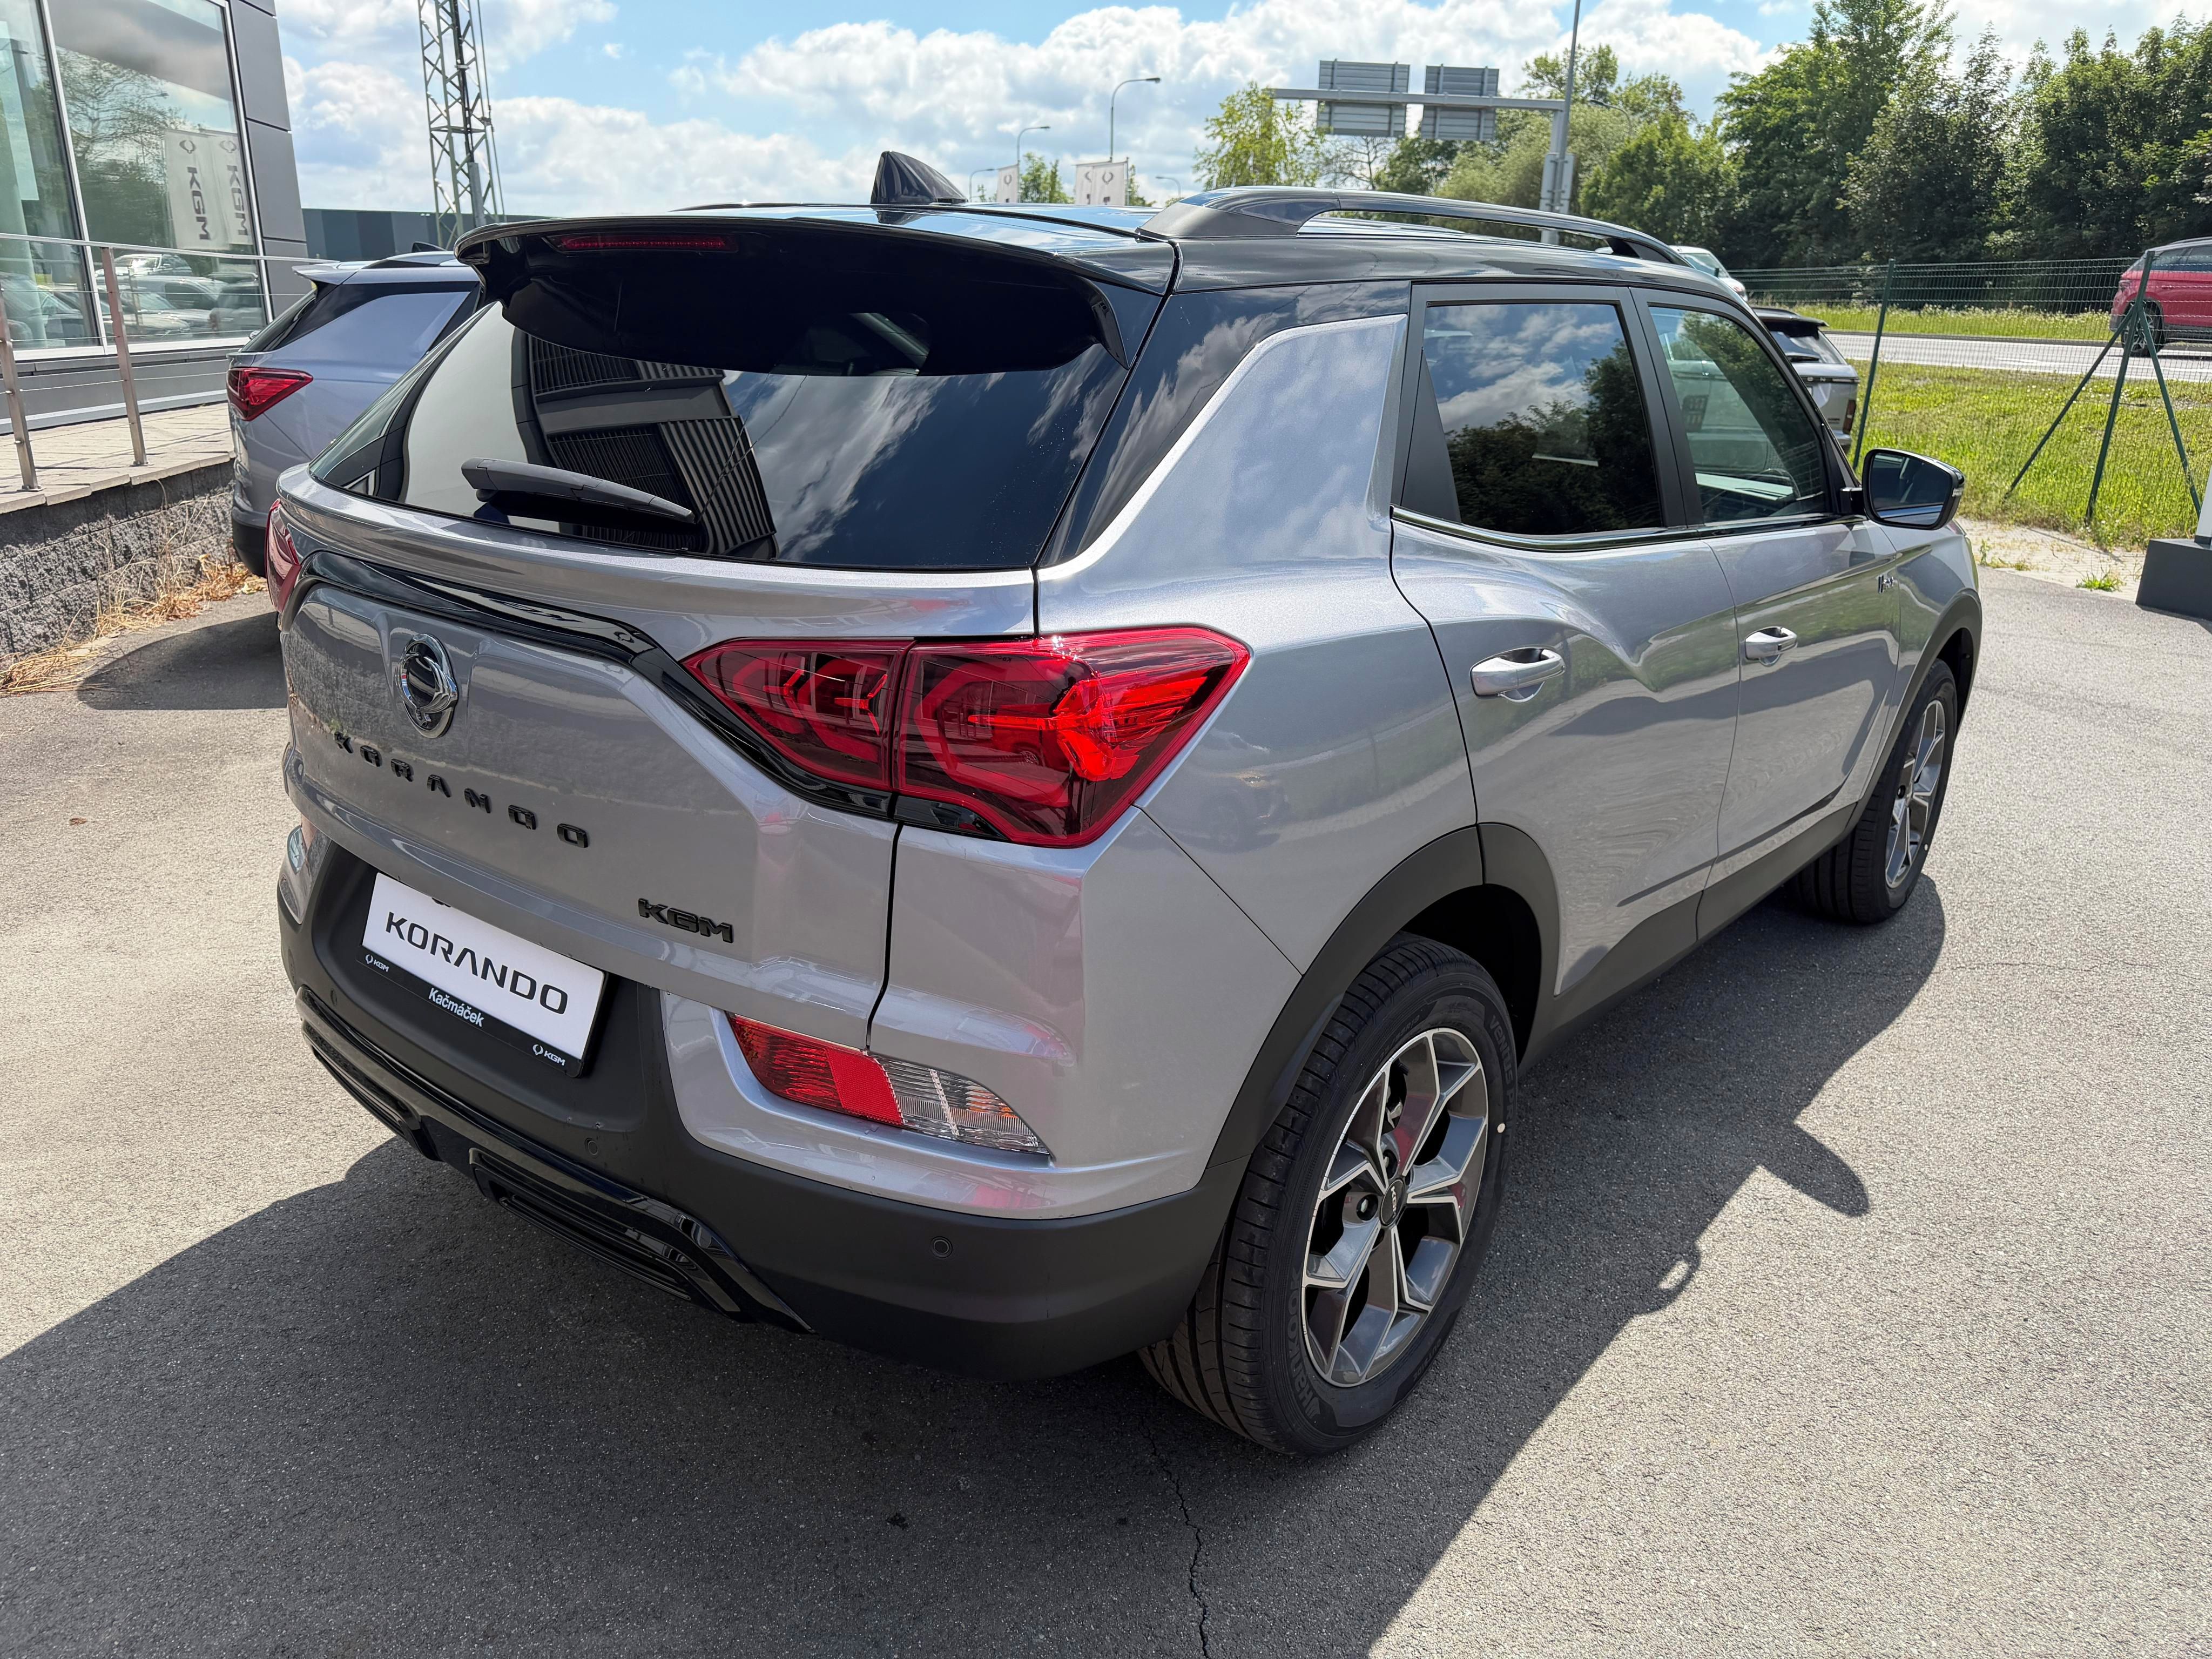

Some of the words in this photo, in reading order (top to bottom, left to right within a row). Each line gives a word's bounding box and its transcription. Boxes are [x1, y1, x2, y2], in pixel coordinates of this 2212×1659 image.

[187, 167, 211, 240] KGM
[227, 166, 248, 235] KGM
[334, 731, 590, 848] KORANDO
[638, 898, 734, 943] KGM
[373, 959, 389, 972] KGM
[386, 911, 568, 1015] KORANDO
[428, 987, 484, 1028] Kačmáček
[544, 1050, 565, 1065] KGM
